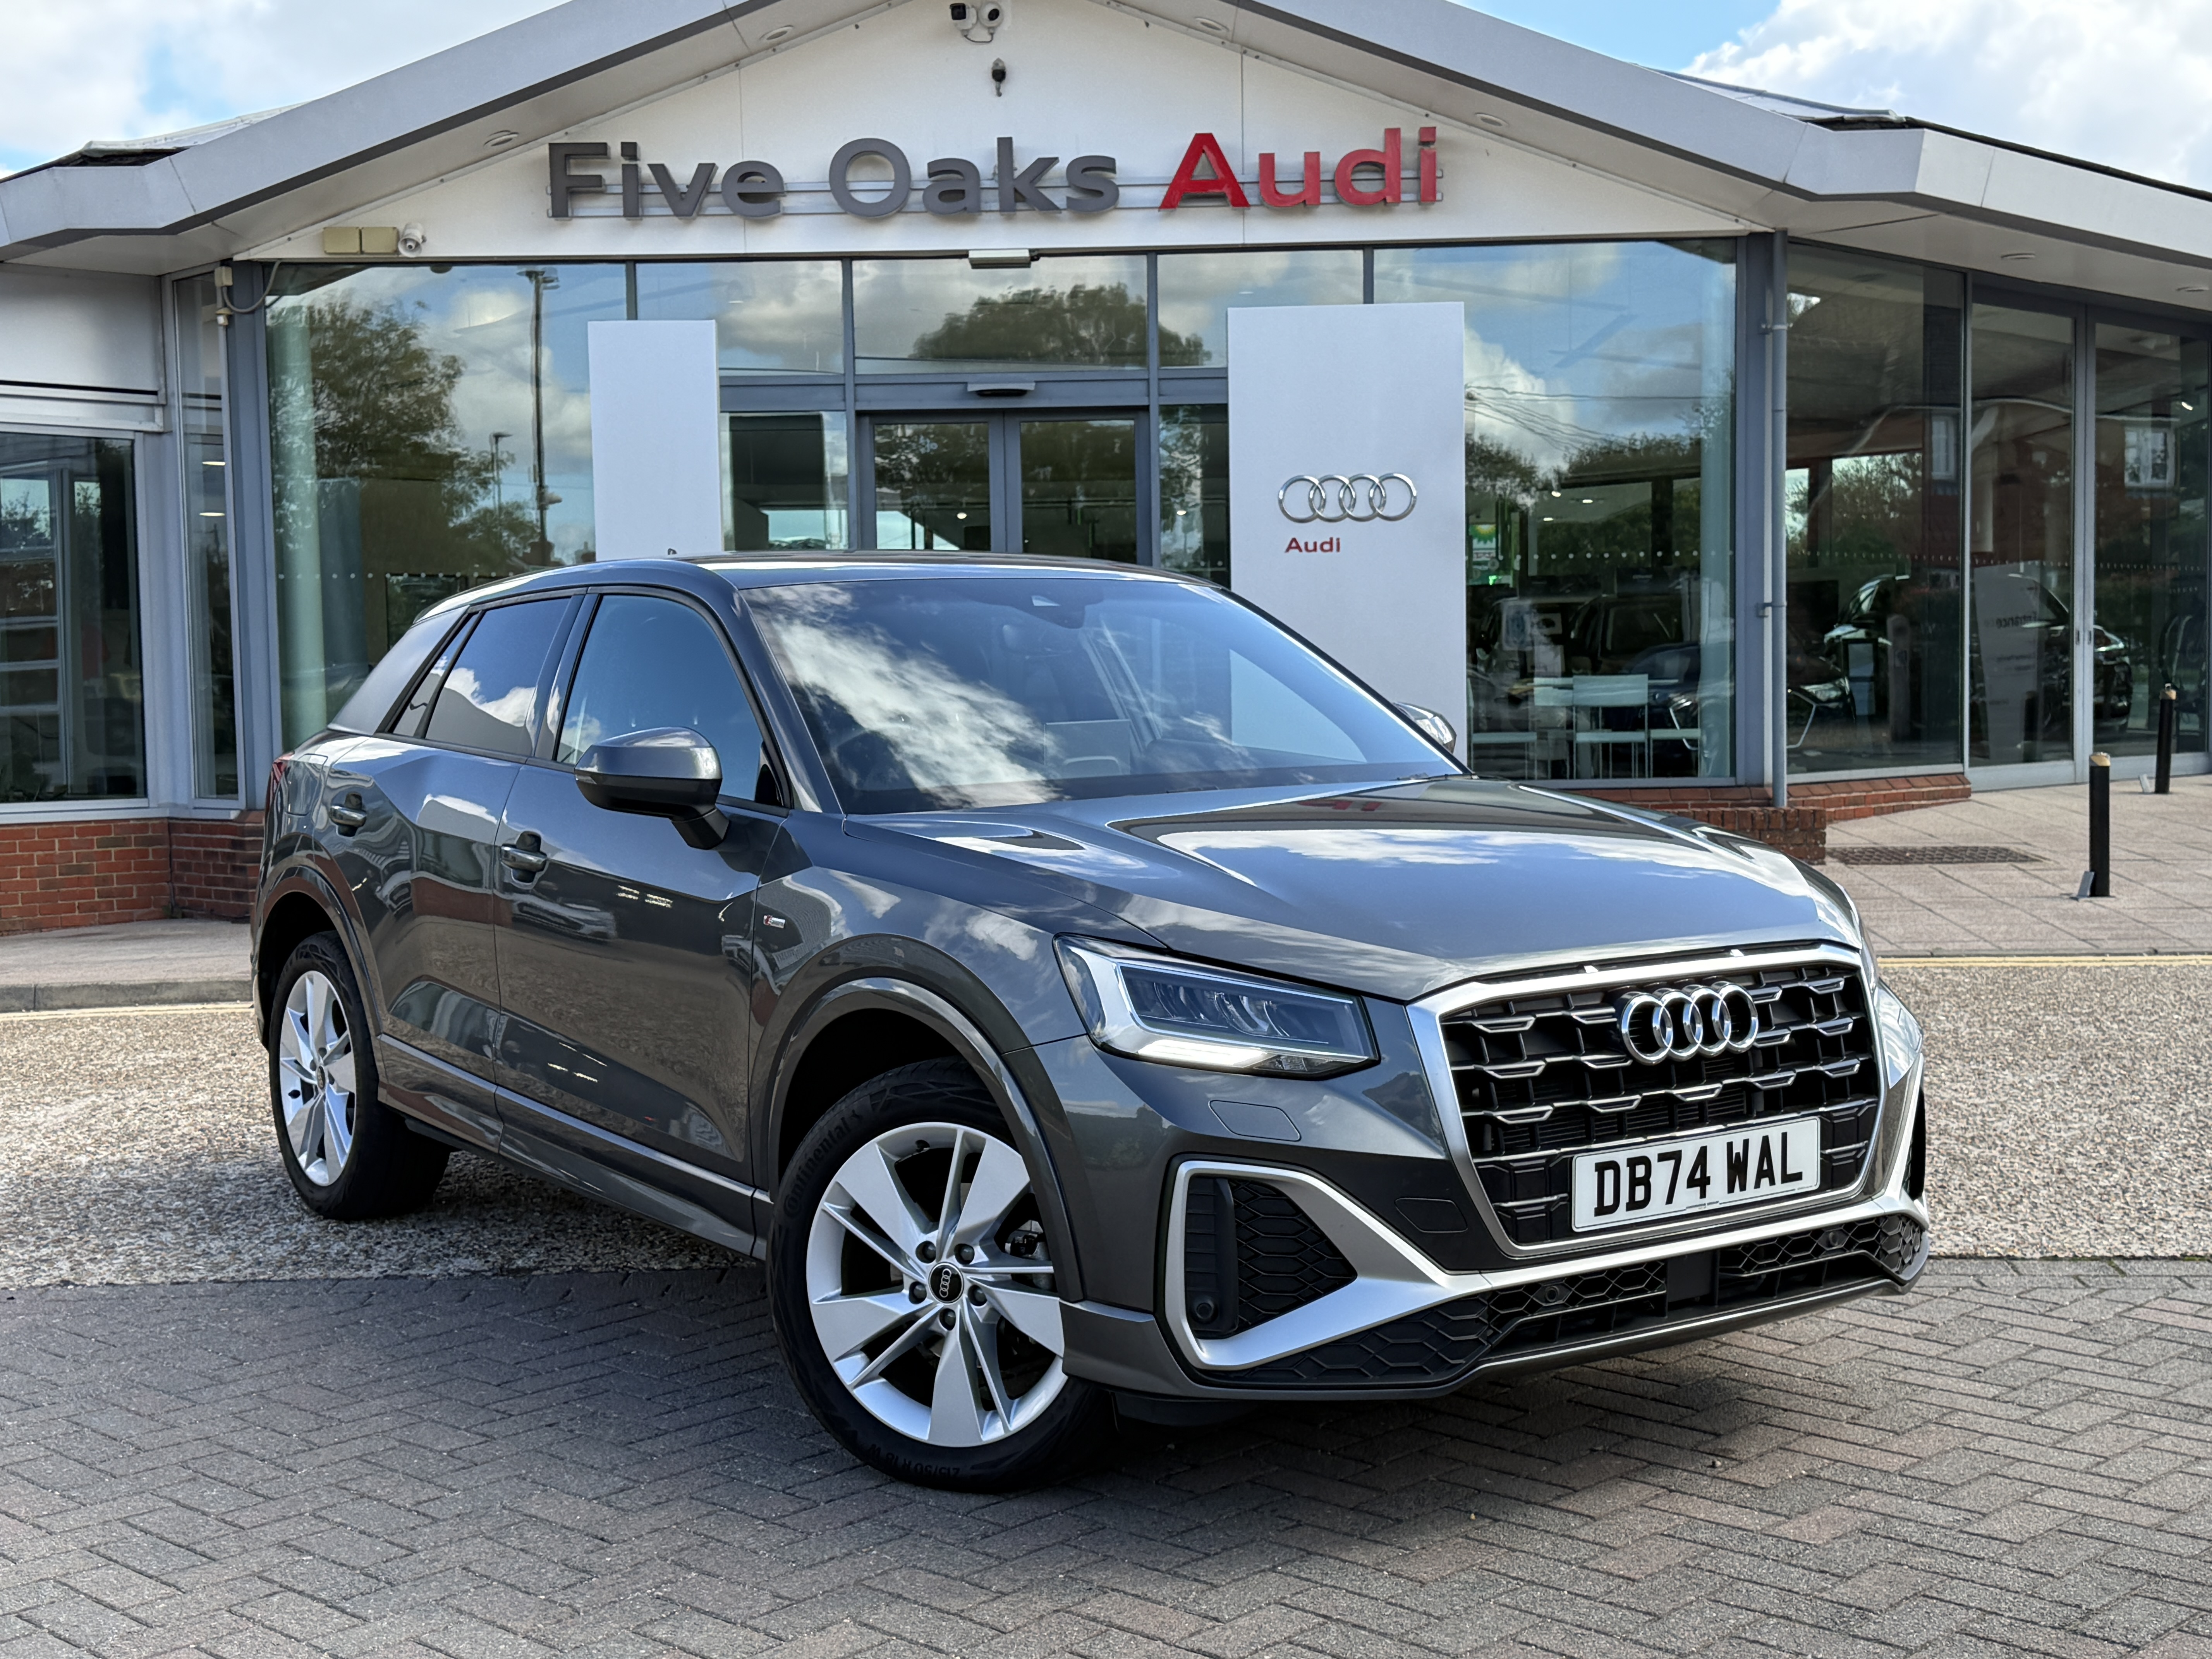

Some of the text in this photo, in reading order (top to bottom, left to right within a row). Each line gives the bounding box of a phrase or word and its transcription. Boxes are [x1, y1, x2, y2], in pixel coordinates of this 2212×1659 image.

[548, 126, 1437, 218] Five Oaks Audi
[1284, 537, 1341, 553] Audi
[1594, 1132, 1803, 1217] DB74 WAL
